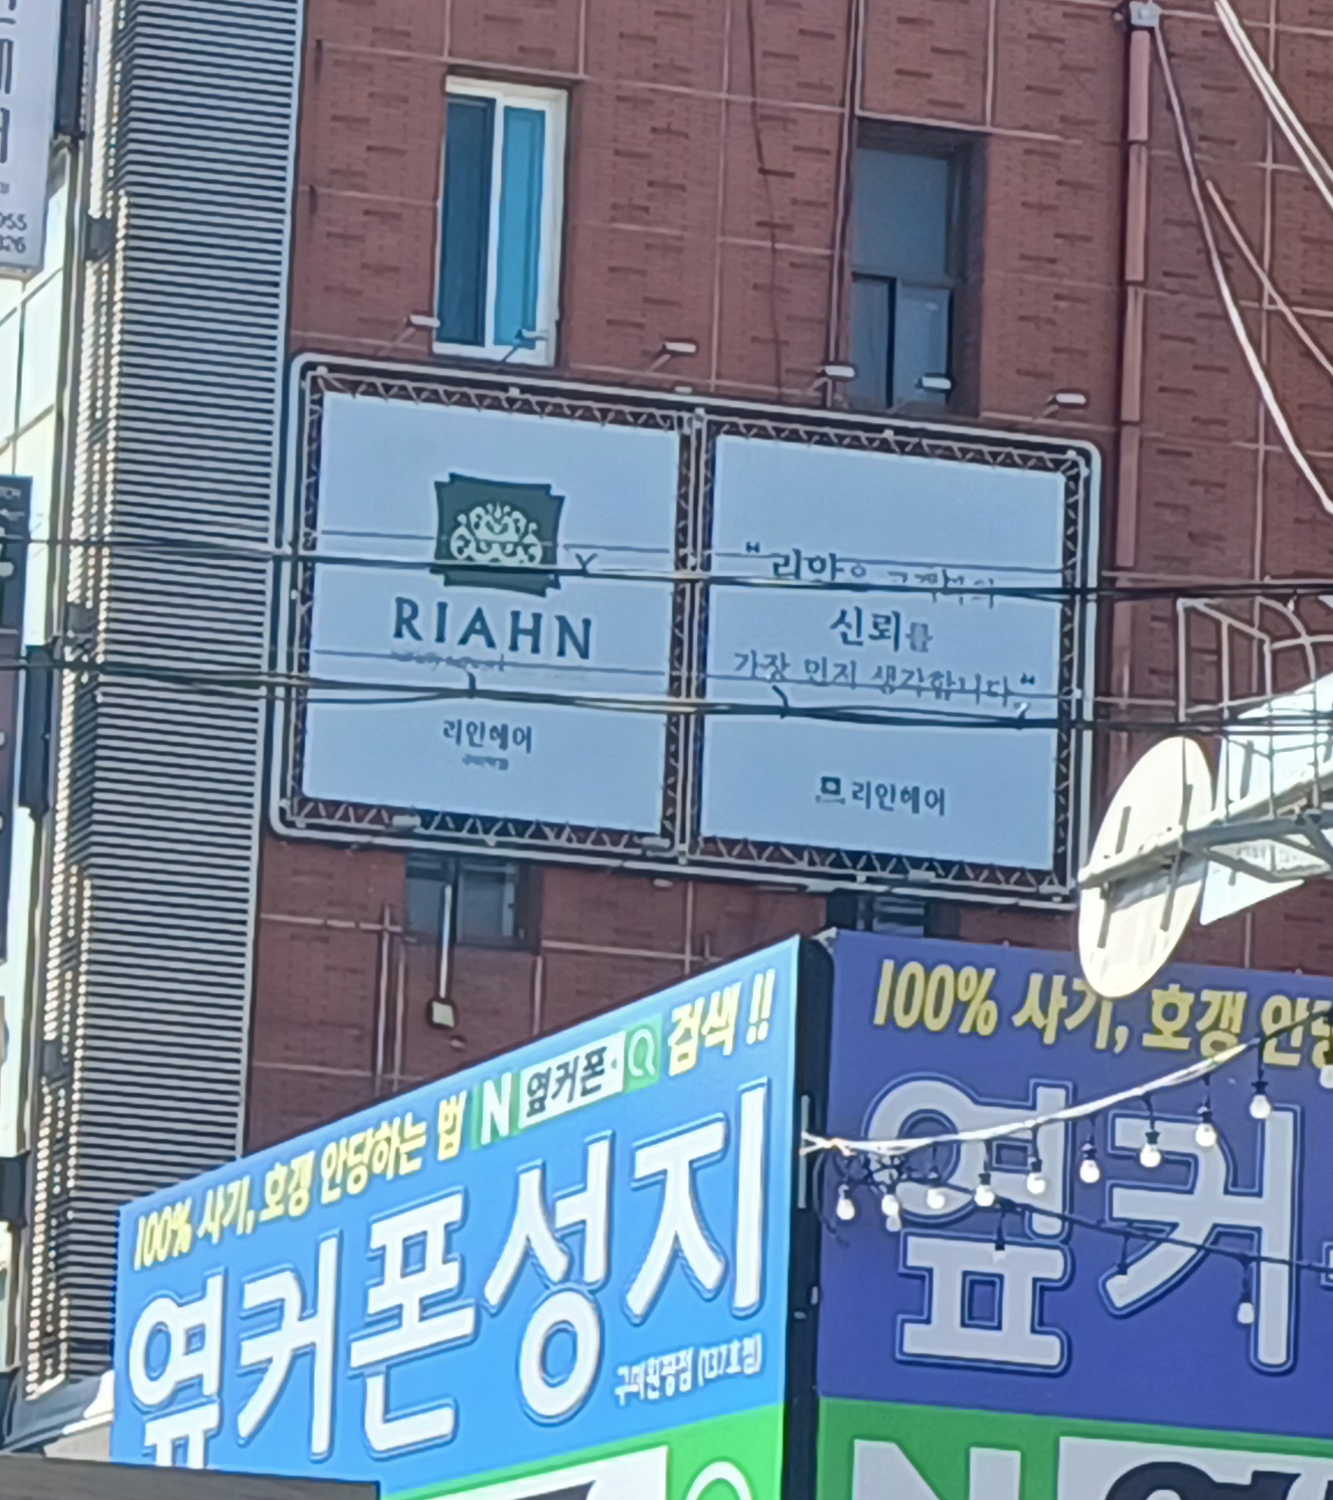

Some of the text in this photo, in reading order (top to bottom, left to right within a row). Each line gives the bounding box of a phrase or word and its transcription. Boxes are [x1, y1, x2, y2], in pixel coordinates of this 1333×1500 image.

[392, 596, 592, 660] RIAHN
[734, 649, 790, 682] 가장
[874, 958, 999, 1037] 100%
[1142, 982, 1249, 1063] 호갱
[134, 1196, 192, 1272] 100%
[319, 1111, 428, 1206] 안당하는
[437, 1089, 468, 1162] 법
[481, 1071, 512, 1146] N
[524, 1045, 609, 1119] 옆커폰
[667, 981, 743, 1077] 검색
[863, 1075, 1333, 1372] 옆커
